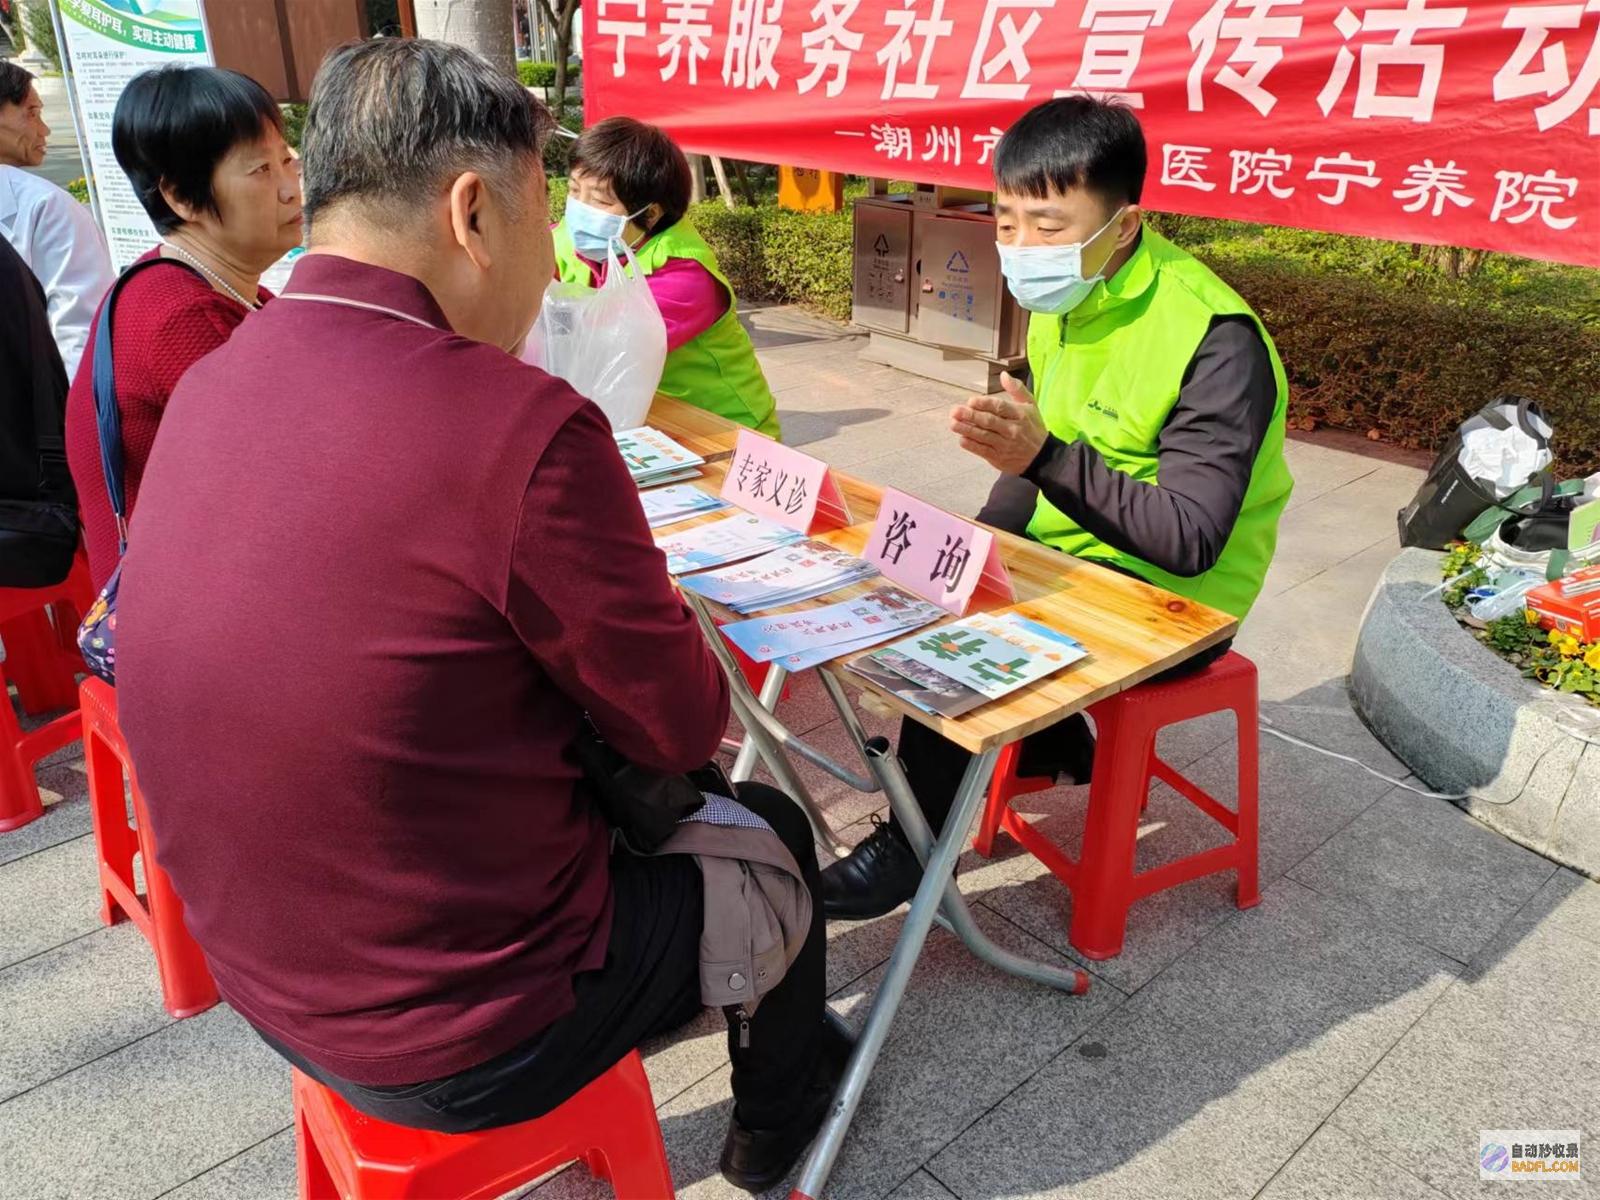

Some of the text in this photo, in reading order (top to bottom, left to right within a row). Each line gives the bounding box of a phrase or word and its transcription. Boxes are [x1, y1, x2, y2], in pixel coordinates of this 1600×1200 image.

[736, 453, 808, 516] 专家义诊
[880, 509, 972, 594] 咨询
